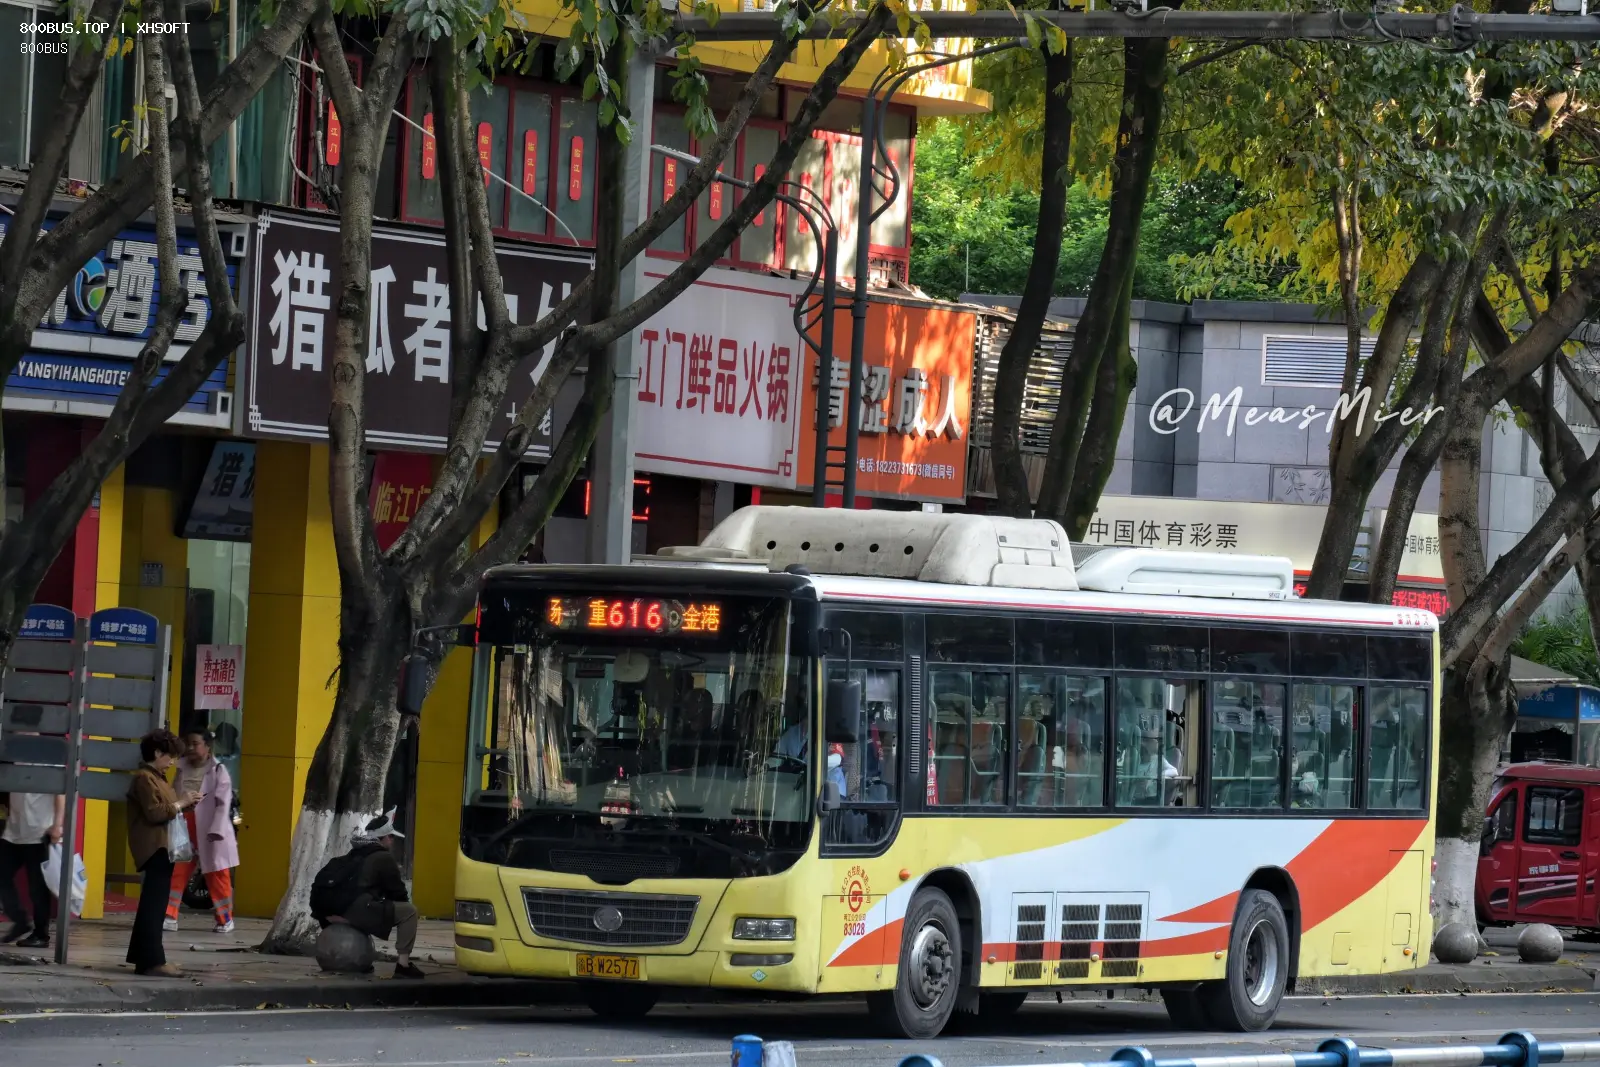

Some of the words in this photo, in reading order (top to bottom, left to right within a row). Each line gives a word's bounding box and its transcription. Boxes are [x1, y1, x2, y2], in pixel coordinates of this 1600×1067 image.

[856, 457, 955, 480] 电话:18223731673(微信同号)
[1088, 518, 1239, 549] 中国体育彩票
[609, 602, 661, 628] 616
[682, 604, 720, 631] 金港
[843, 922, 866, 936] 83028
